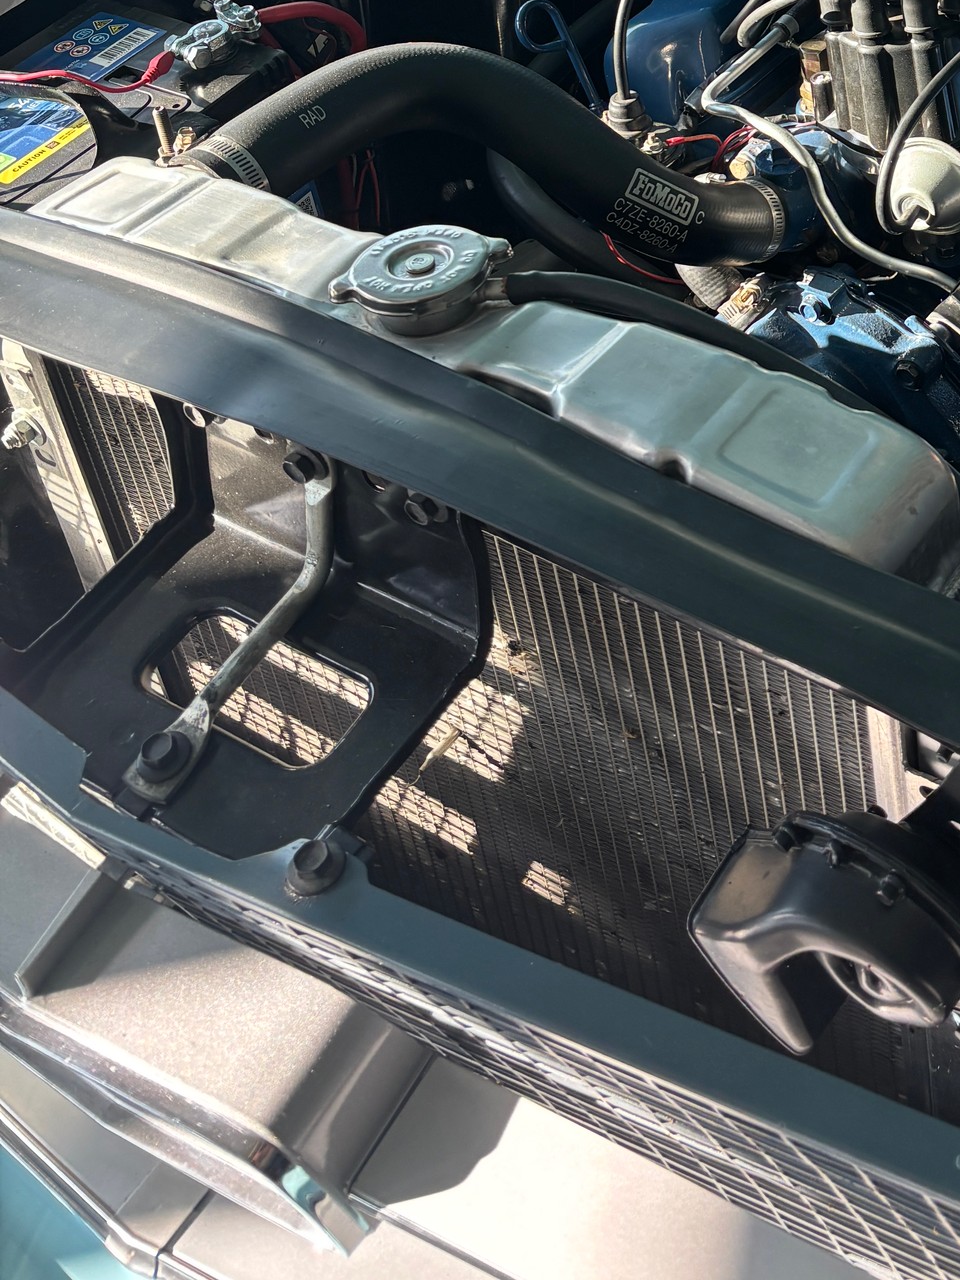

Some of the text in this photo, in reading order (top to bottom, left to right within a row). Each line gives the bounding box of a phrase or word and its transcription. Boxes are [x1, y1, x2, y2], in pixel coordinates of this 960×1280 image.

[299, 105, 327, 129] RAD
[12, 149, 47, 173] CAUTION
[614, 198, 688, 242] C7ZE-8260-A
[632, 174, 705, 225] FoMoCo C
[606, 212, 678, 254] C4DZ-8260-A
